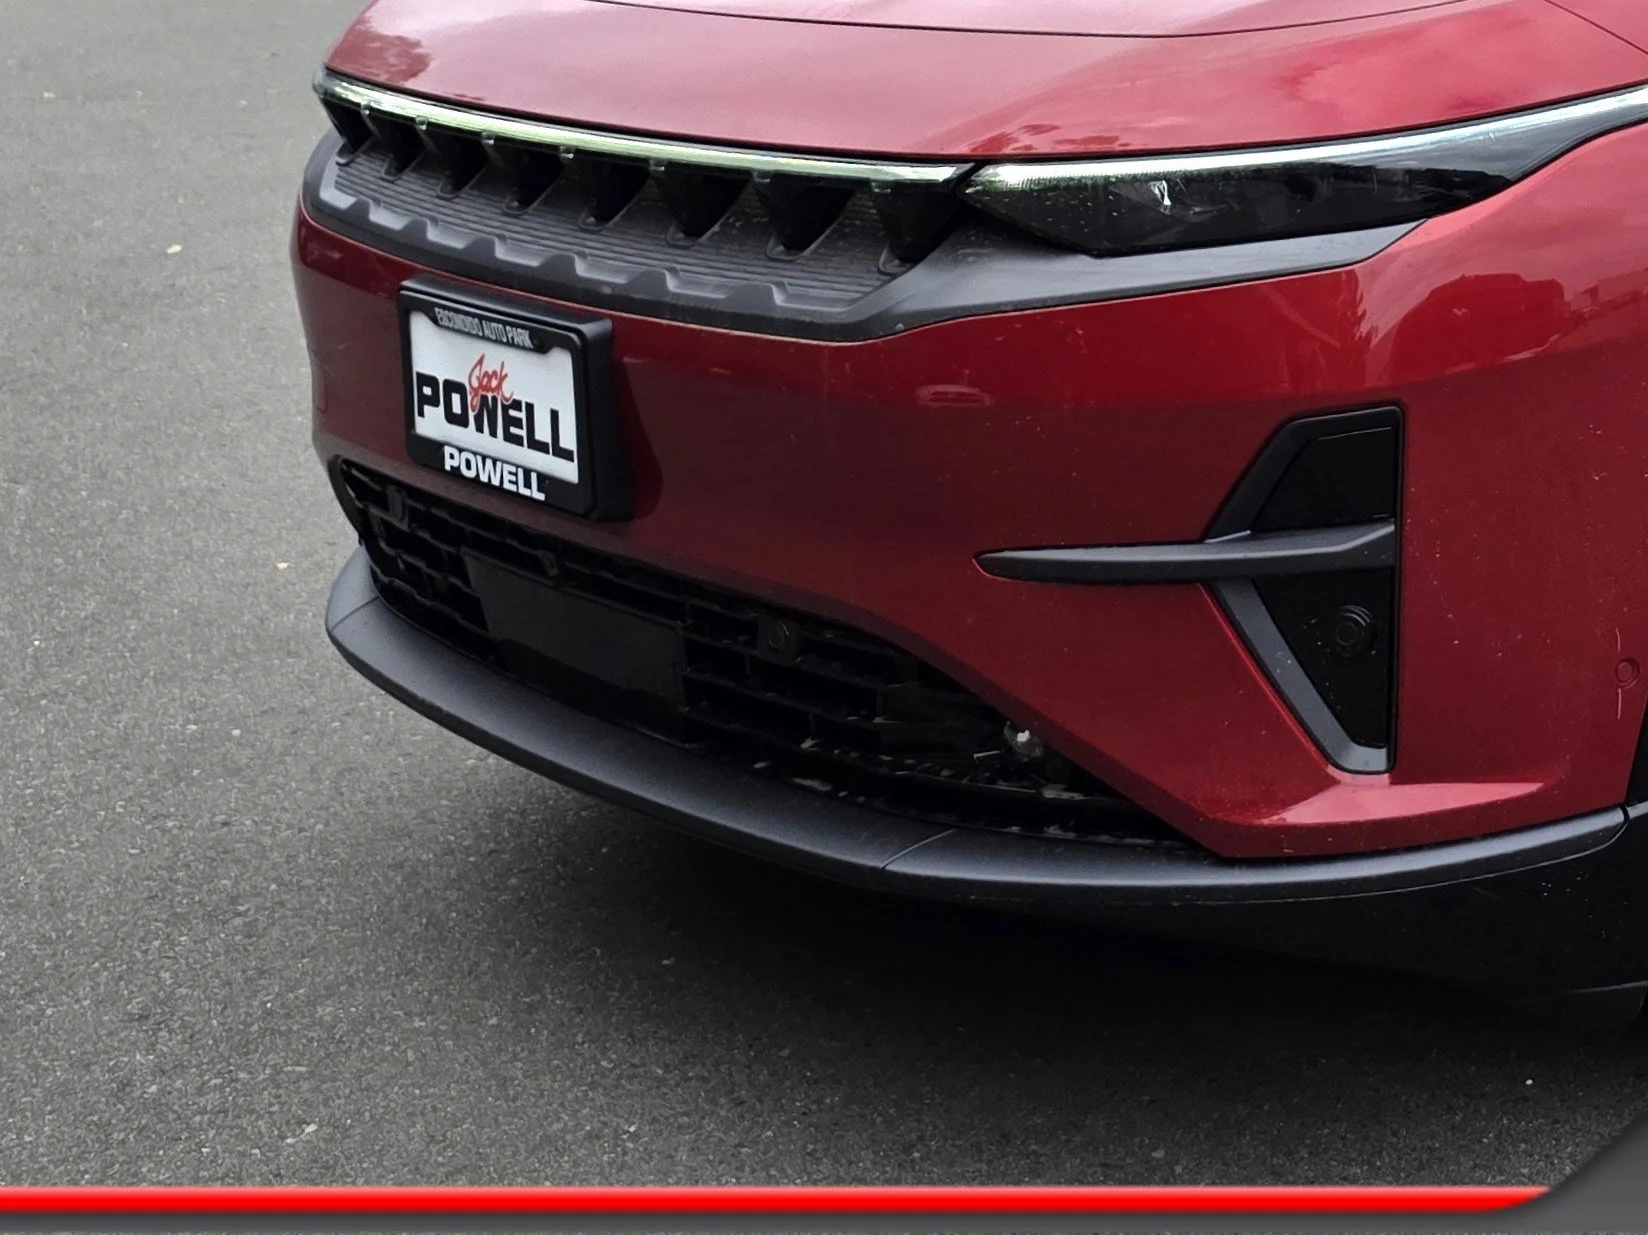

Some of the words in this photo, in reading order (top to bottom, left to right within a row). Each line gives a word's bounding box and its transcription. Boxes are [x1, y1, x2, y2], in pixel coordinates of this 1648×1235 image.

[482, 320, 508, 343] AUTO
[505, 325, 534, 349] PARK
[468, 353, 514, 413] Jack
[415, 370, 575, 463] POWELL
[443, 445, 546, 502] POWELL
